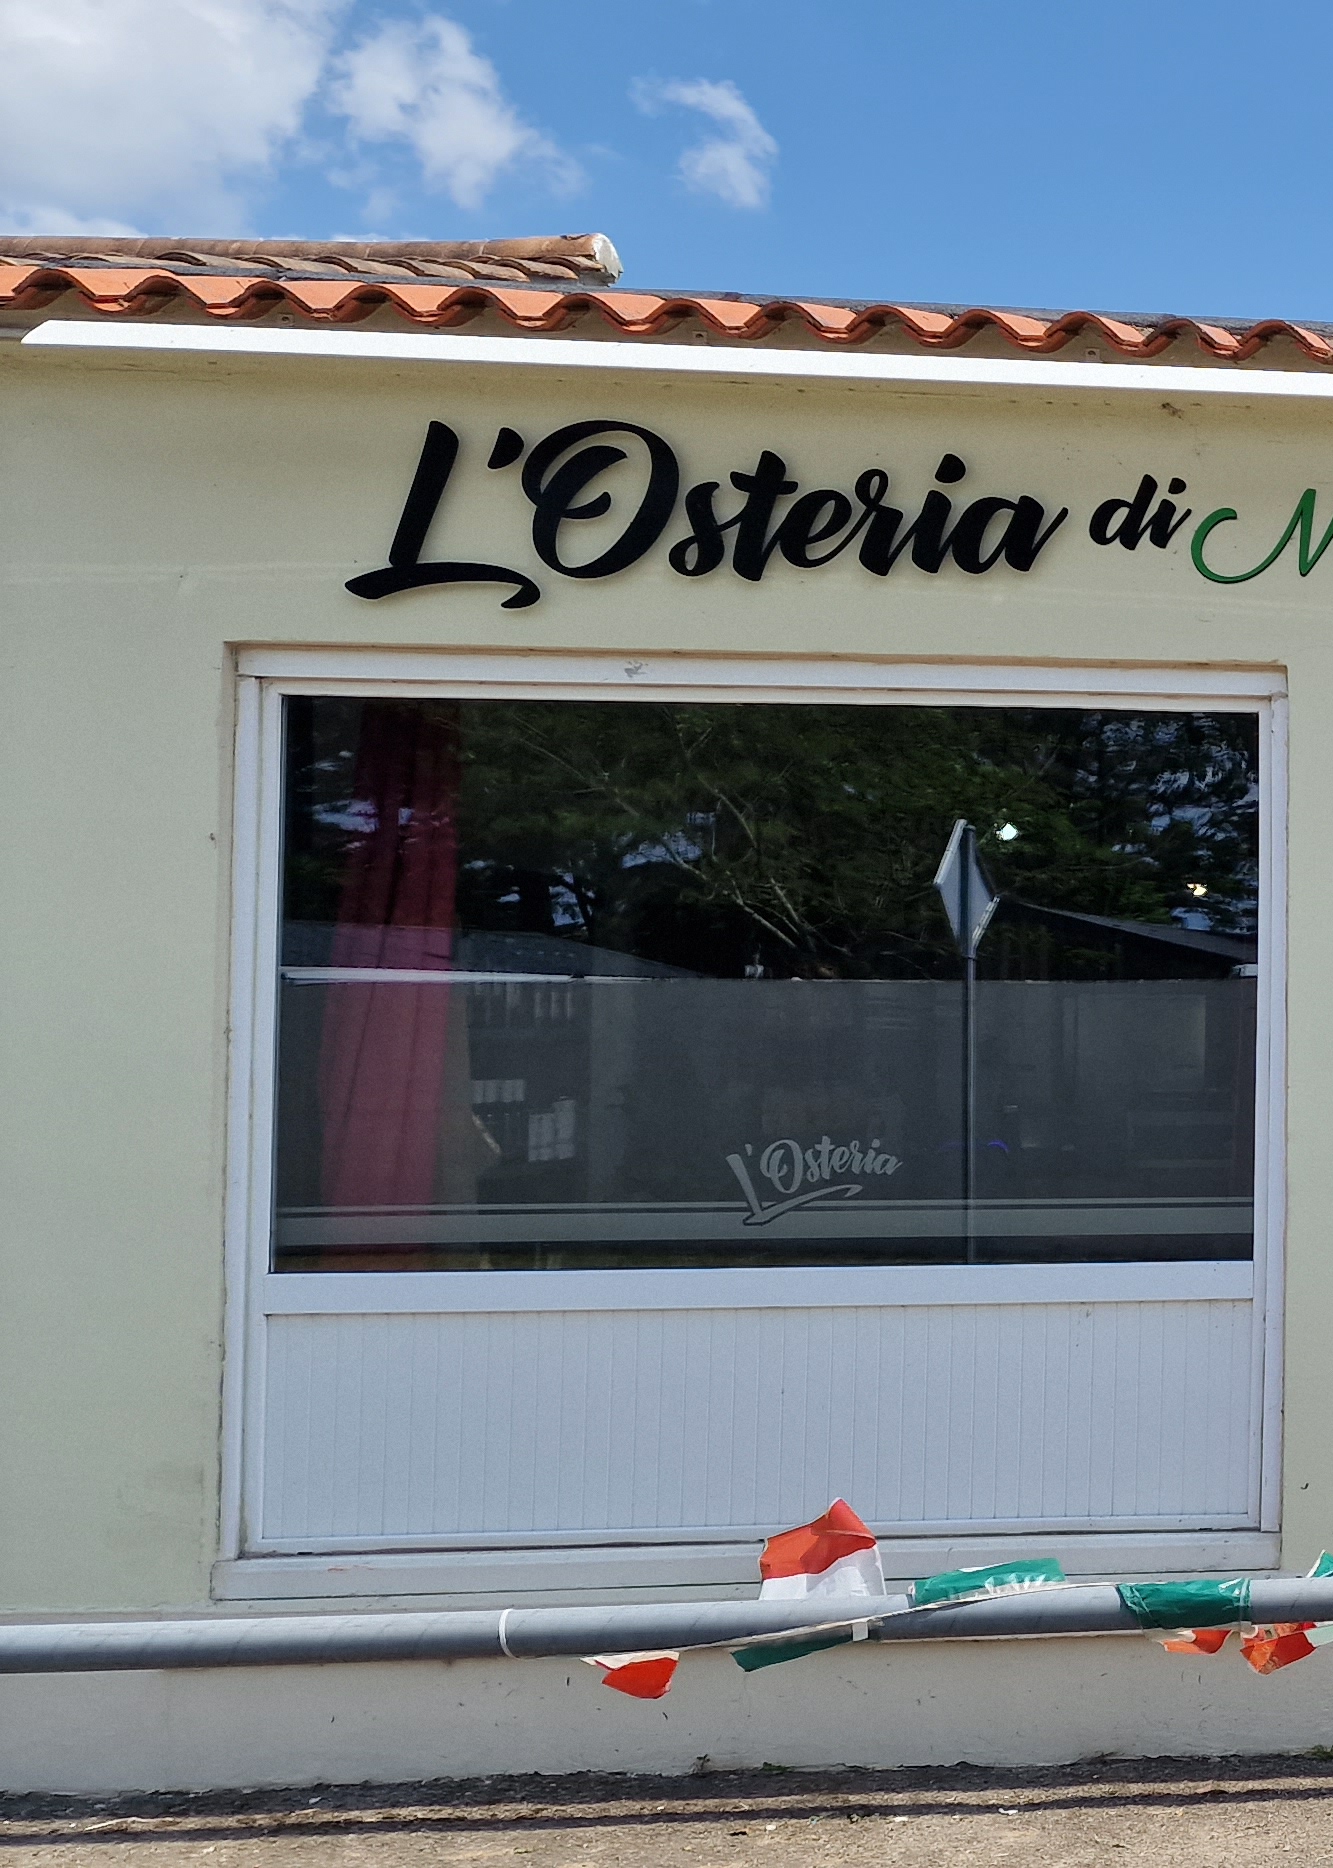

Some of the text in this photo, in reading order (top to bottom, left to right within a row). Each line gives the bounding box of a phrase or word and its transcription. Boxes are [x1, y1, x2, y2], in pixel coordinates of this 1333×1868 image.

[344, 419, 1070, 609] L'Osteria
[1088, 473, 1192, 551] di
[725, 1135, 903, 1226] L'Osteria
